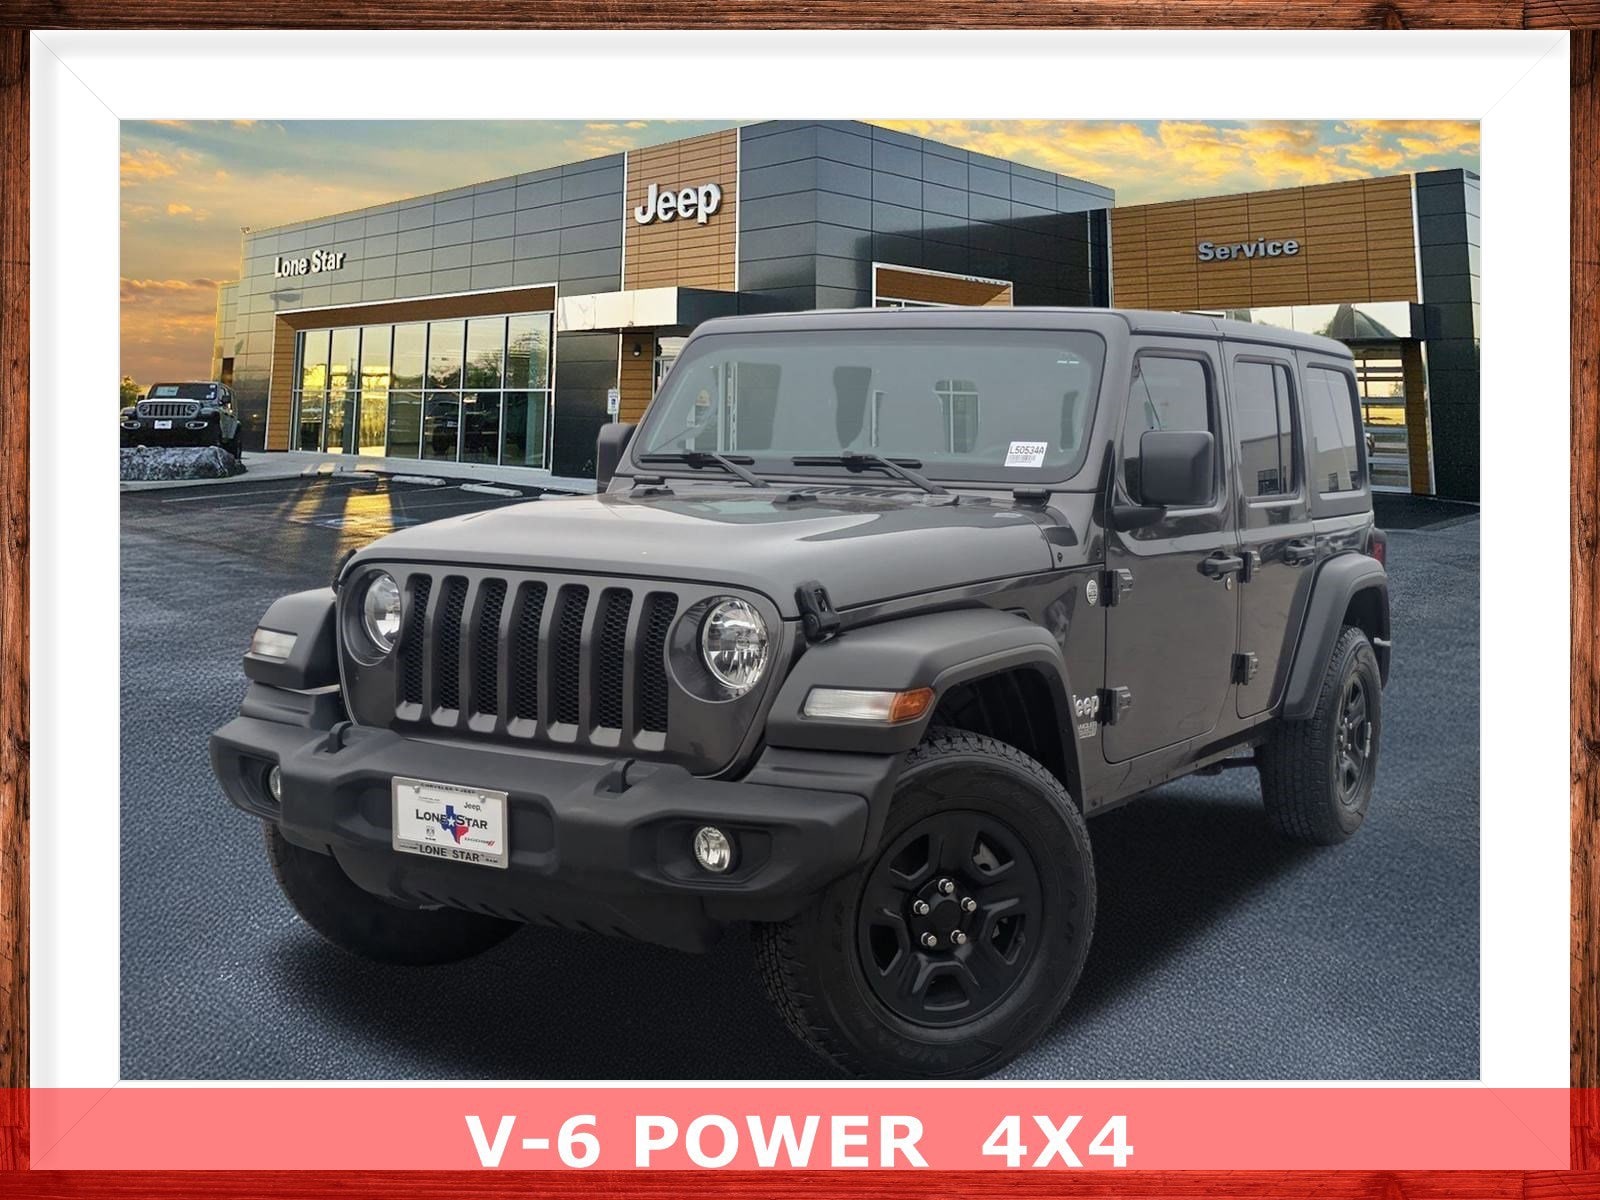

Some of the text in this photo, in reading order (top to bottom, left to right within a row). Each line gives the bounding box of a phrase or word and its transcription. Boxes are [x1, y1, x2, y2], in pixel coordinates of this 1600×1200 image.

[634, 182, 721, 225] Jeep
[1198, 237, 1299, 261] Service
[275, 249, 346, 278] Lone Star
[415, 809, 488, 830] LONE STAR
[420, 844, 448, 857] LONE
[452, 849, 480, 862] STAR
